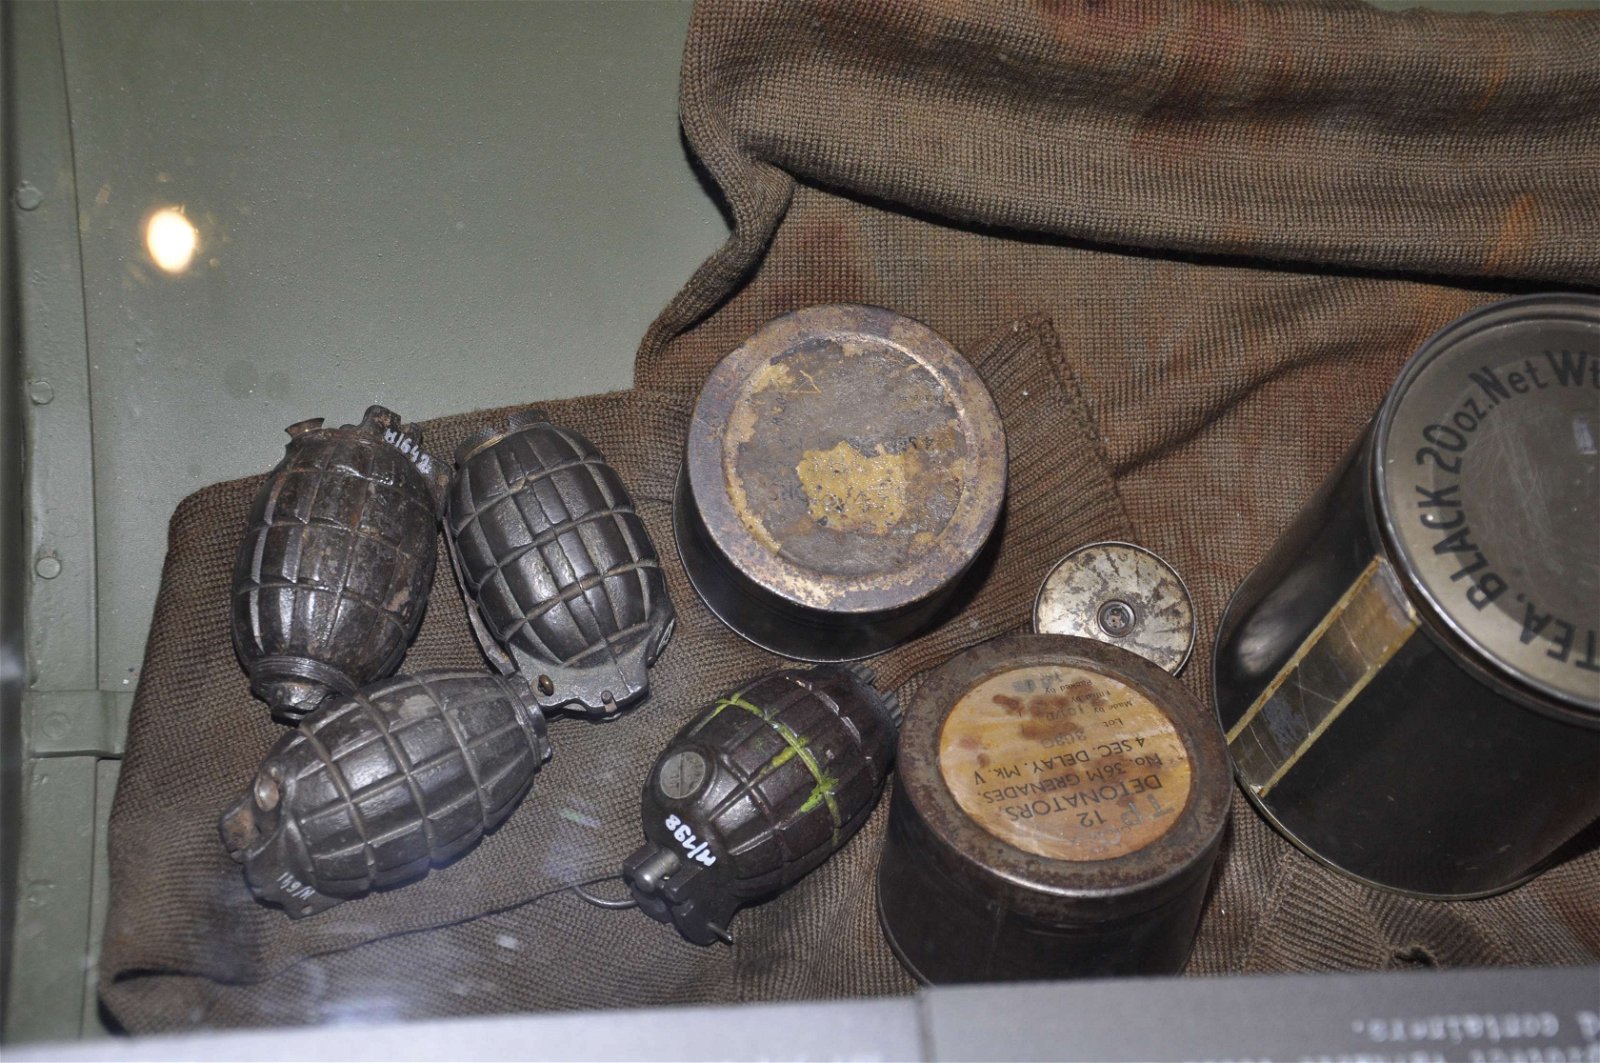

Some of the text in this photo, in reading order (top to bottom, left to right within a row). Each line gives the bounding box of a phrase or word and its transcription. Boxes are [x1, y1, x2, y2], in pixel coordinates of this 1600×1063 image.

[1415, 485, 1508, 612] BLACK
[1103, 717, 1124, 728] Lot
[1092, 739, 1133, 758] SEC.
[1135, 736, 1145, 748] 4
[974, 771, 987, 785] V
[1077, 810, 1107, 827] 12
